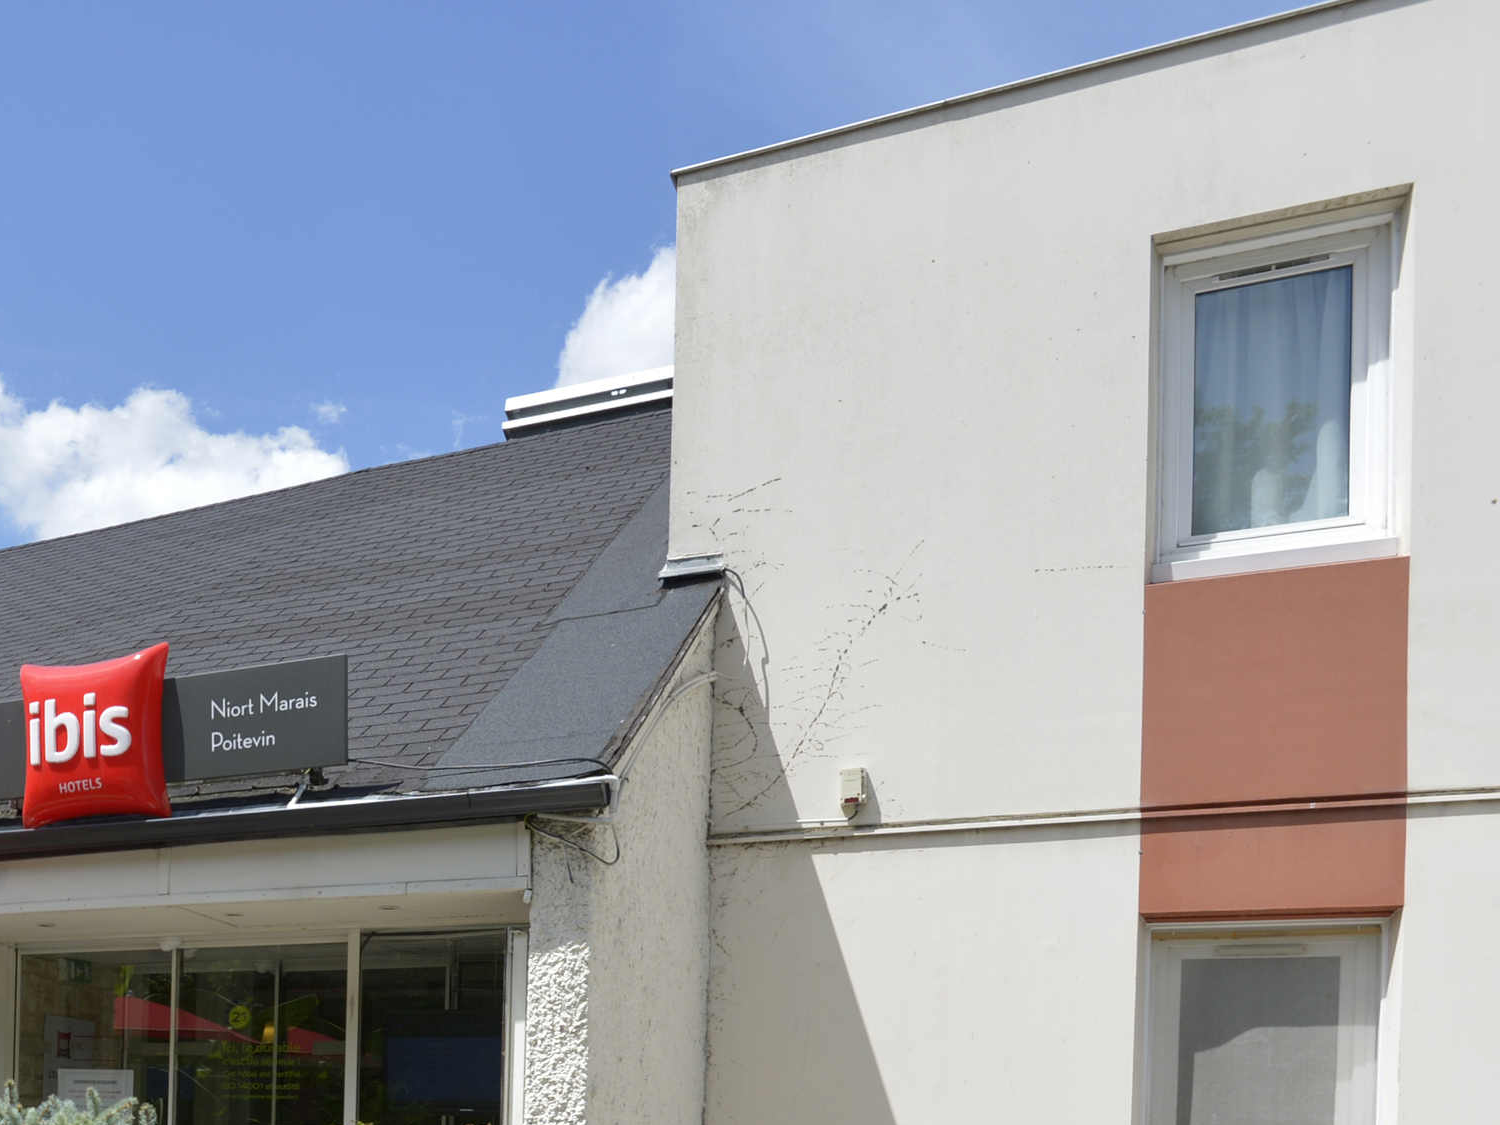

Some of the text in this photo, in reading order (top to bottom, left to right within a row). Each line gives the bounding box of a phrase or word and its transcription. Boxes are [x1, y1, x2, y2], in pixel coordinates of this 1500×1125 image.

[211, 691, 318, 720] Niort Marais
[29, 692, 132, 766] ibis
[211, 731, 276, 752] Poitevin
[59, 778, 102, 793] HOTELS
